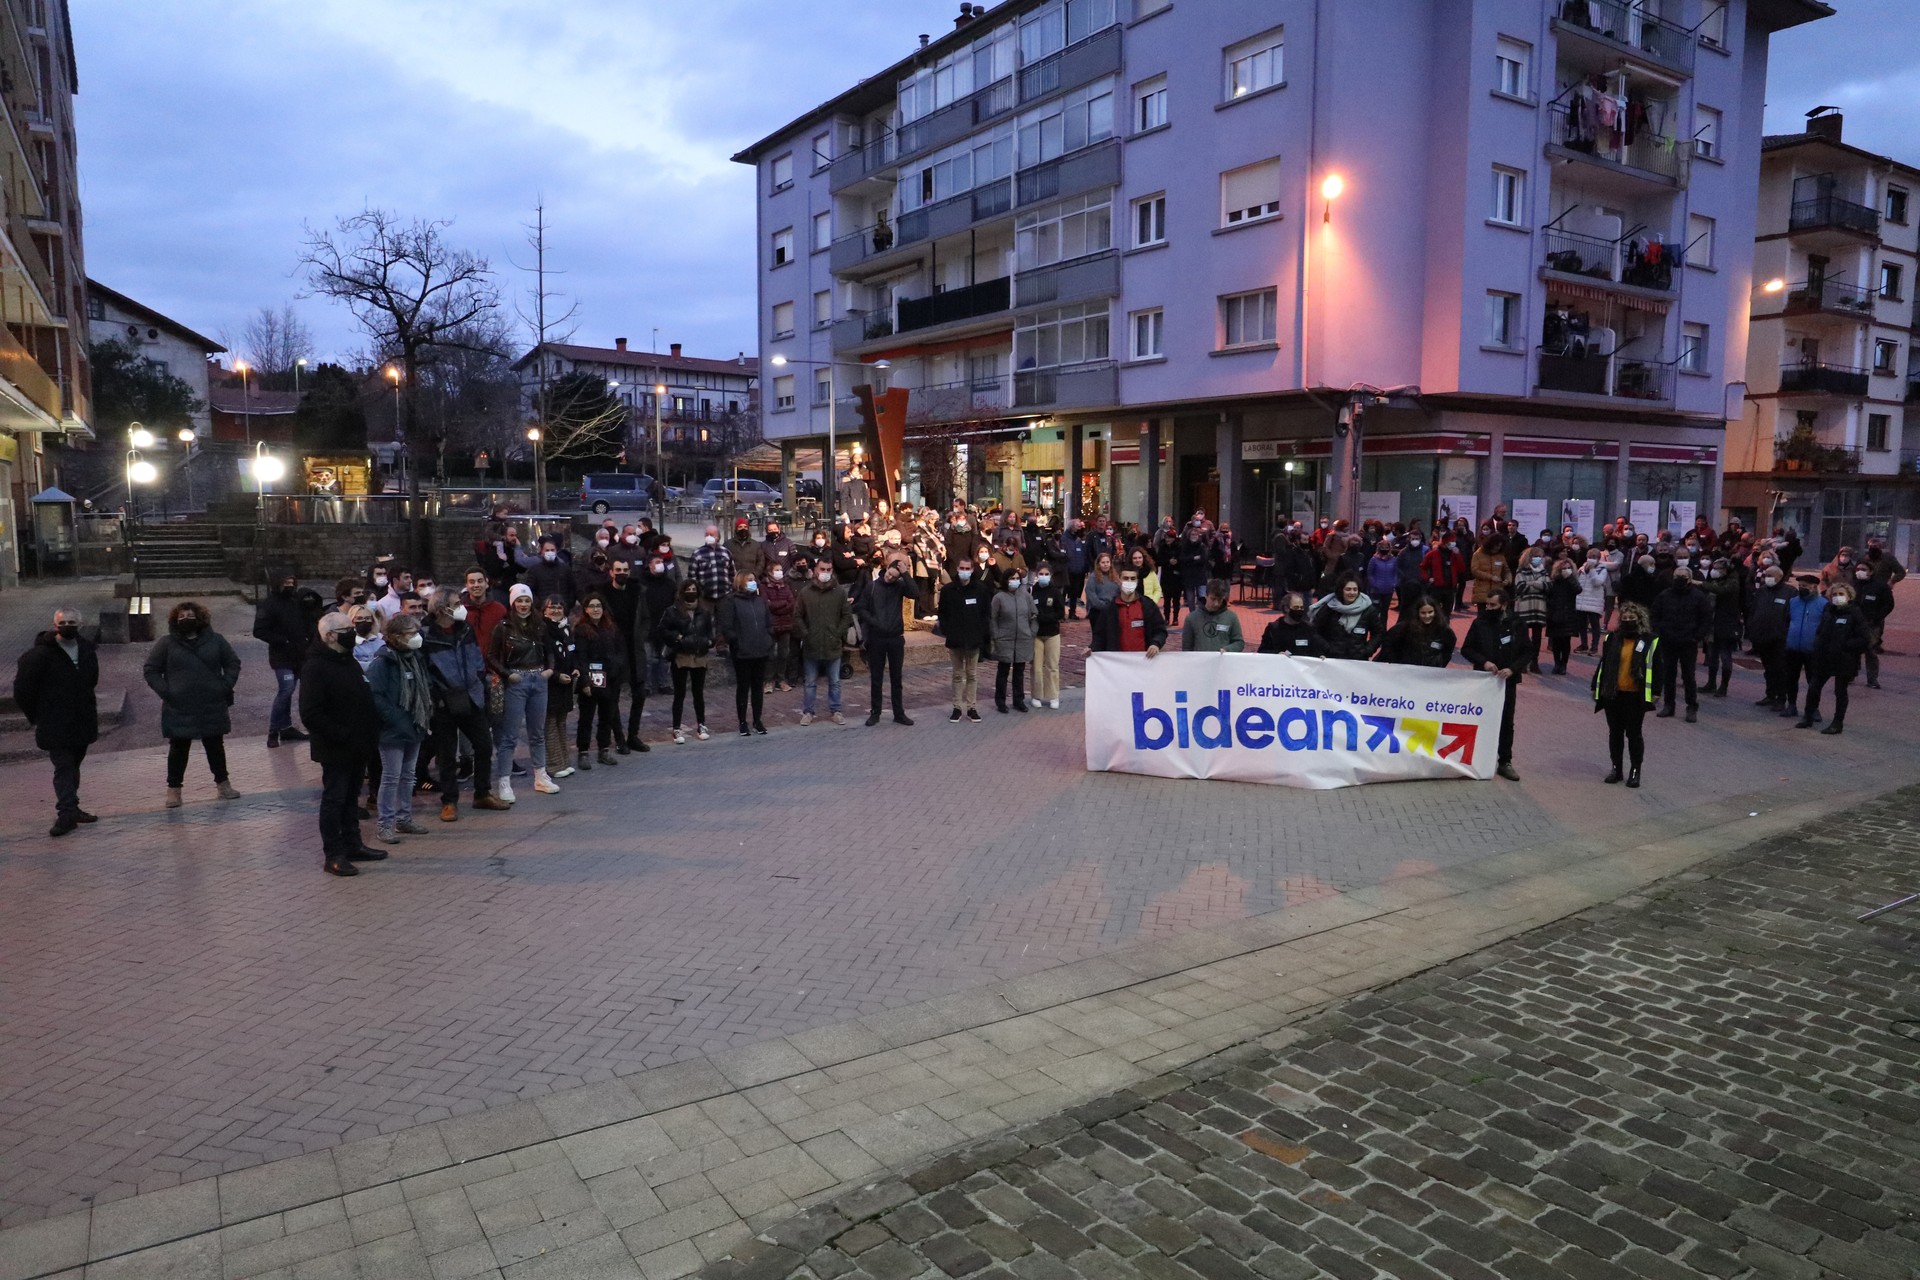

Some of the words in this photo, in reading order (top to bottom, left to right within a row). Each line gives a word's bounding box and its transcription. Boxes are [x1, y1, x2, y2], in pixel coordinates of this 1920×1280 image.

[1243, 443, 1275, 453] LABORAL
[1236, 684, 1343, 703] elkarbizitzarako
[1351, 692, 1415, 711] bakerako
[1425, 700, 1483, 716] etxerako
[1131, 690, 1358, 752] bidean
